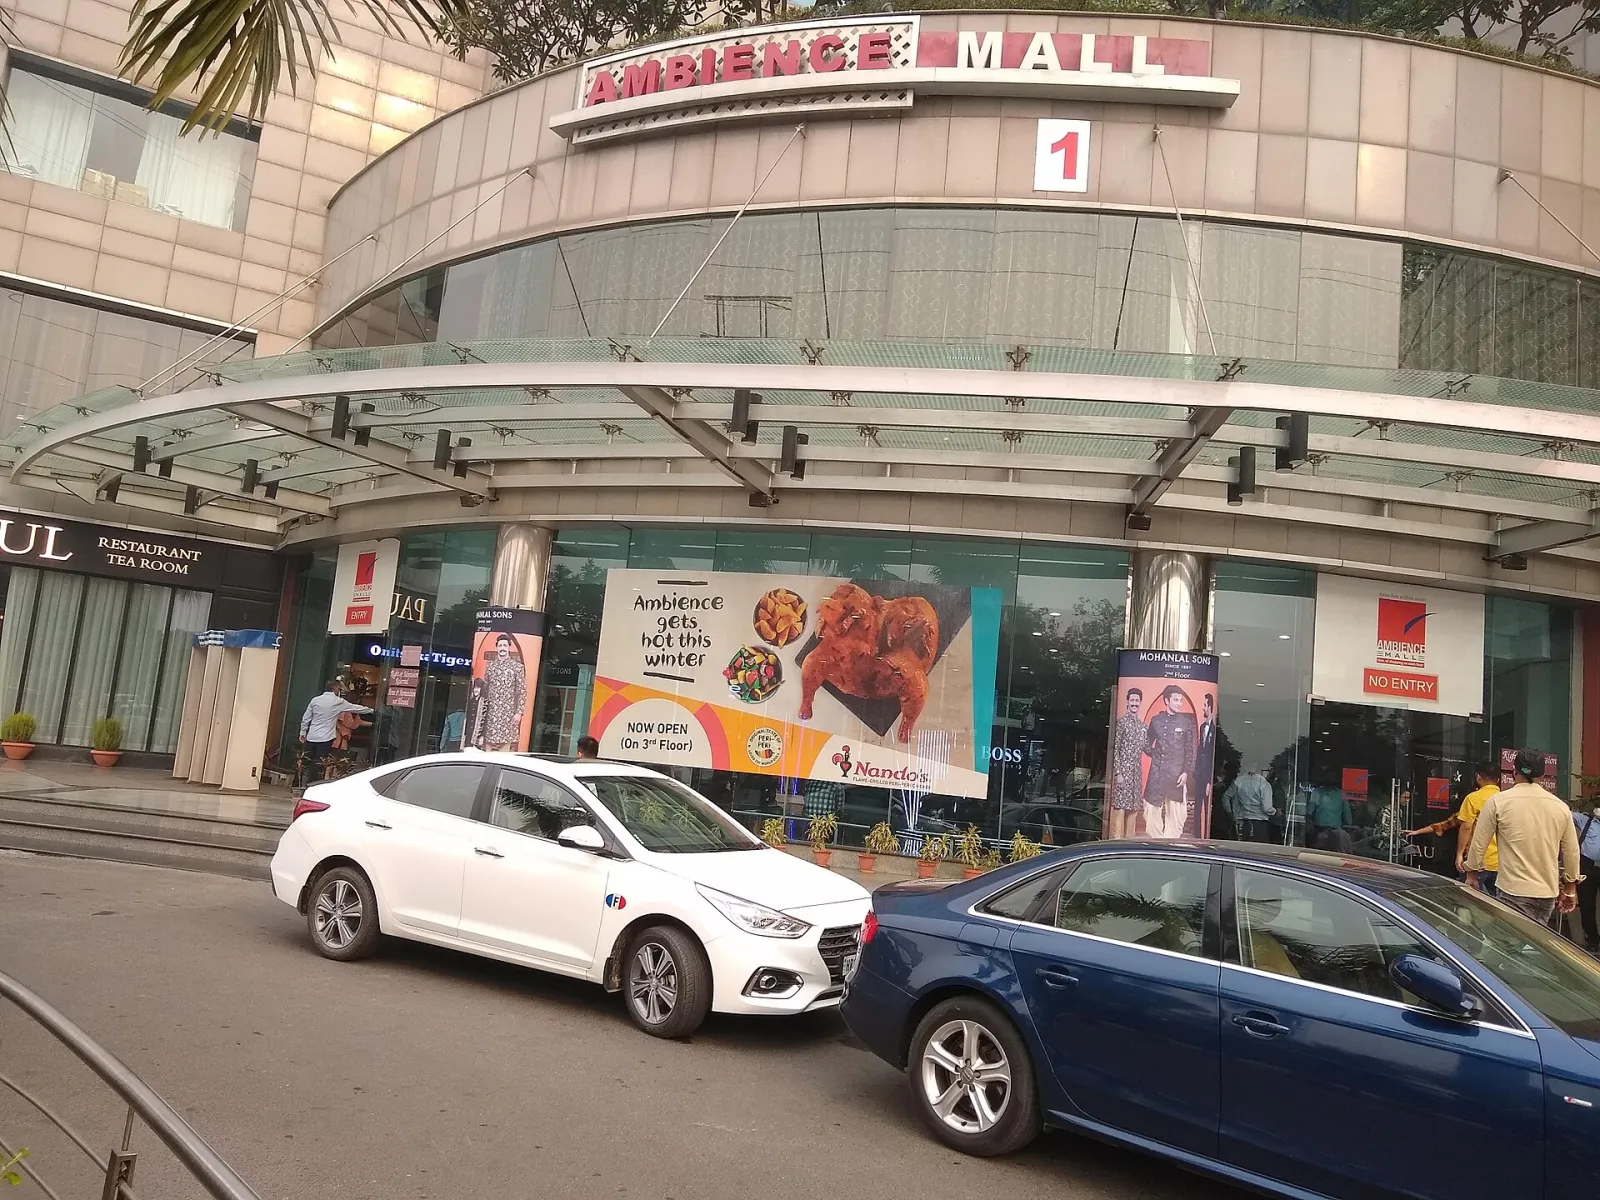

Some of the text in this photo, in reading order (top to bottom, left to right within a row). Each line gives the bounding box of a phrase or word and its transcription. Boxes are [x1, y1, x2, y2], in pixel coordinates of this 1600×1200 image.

[585, 31, 1165, 107] AMBIENCE MALL
[1050, 131, 1079, 180] 1
[98, 536, 202, 562] RESTAURANT
[107, 553, 189, 575] TEA ROOM
[633, 592, 724, 611] Ambience
[350, 611, 368, 620] ENTRY
[492, 611, 513, 619] SONS
[657, 613, 698, 633] gets
[641, 629, 711, 648] hot this
[1377, 640, 1426, 655] AMBIENCE
[431, 652, 472, 667] Tiger
[645, 648, 706, 667] winter
[1139, 652, 1211, 665] MOHANLAL SONS
[1384, 652, 1417, 661] MALL
[1369, 675, 1434, 693] NO ENTRY
[627, 722, 688, 734] NOW OPEN
[620, 737, 693, 752] (On 3rd Floor)
[981, 745, 1022, 763] BOSS
[854, 761, 929, 783] Nando's
[613, 896, 619, 907] F
